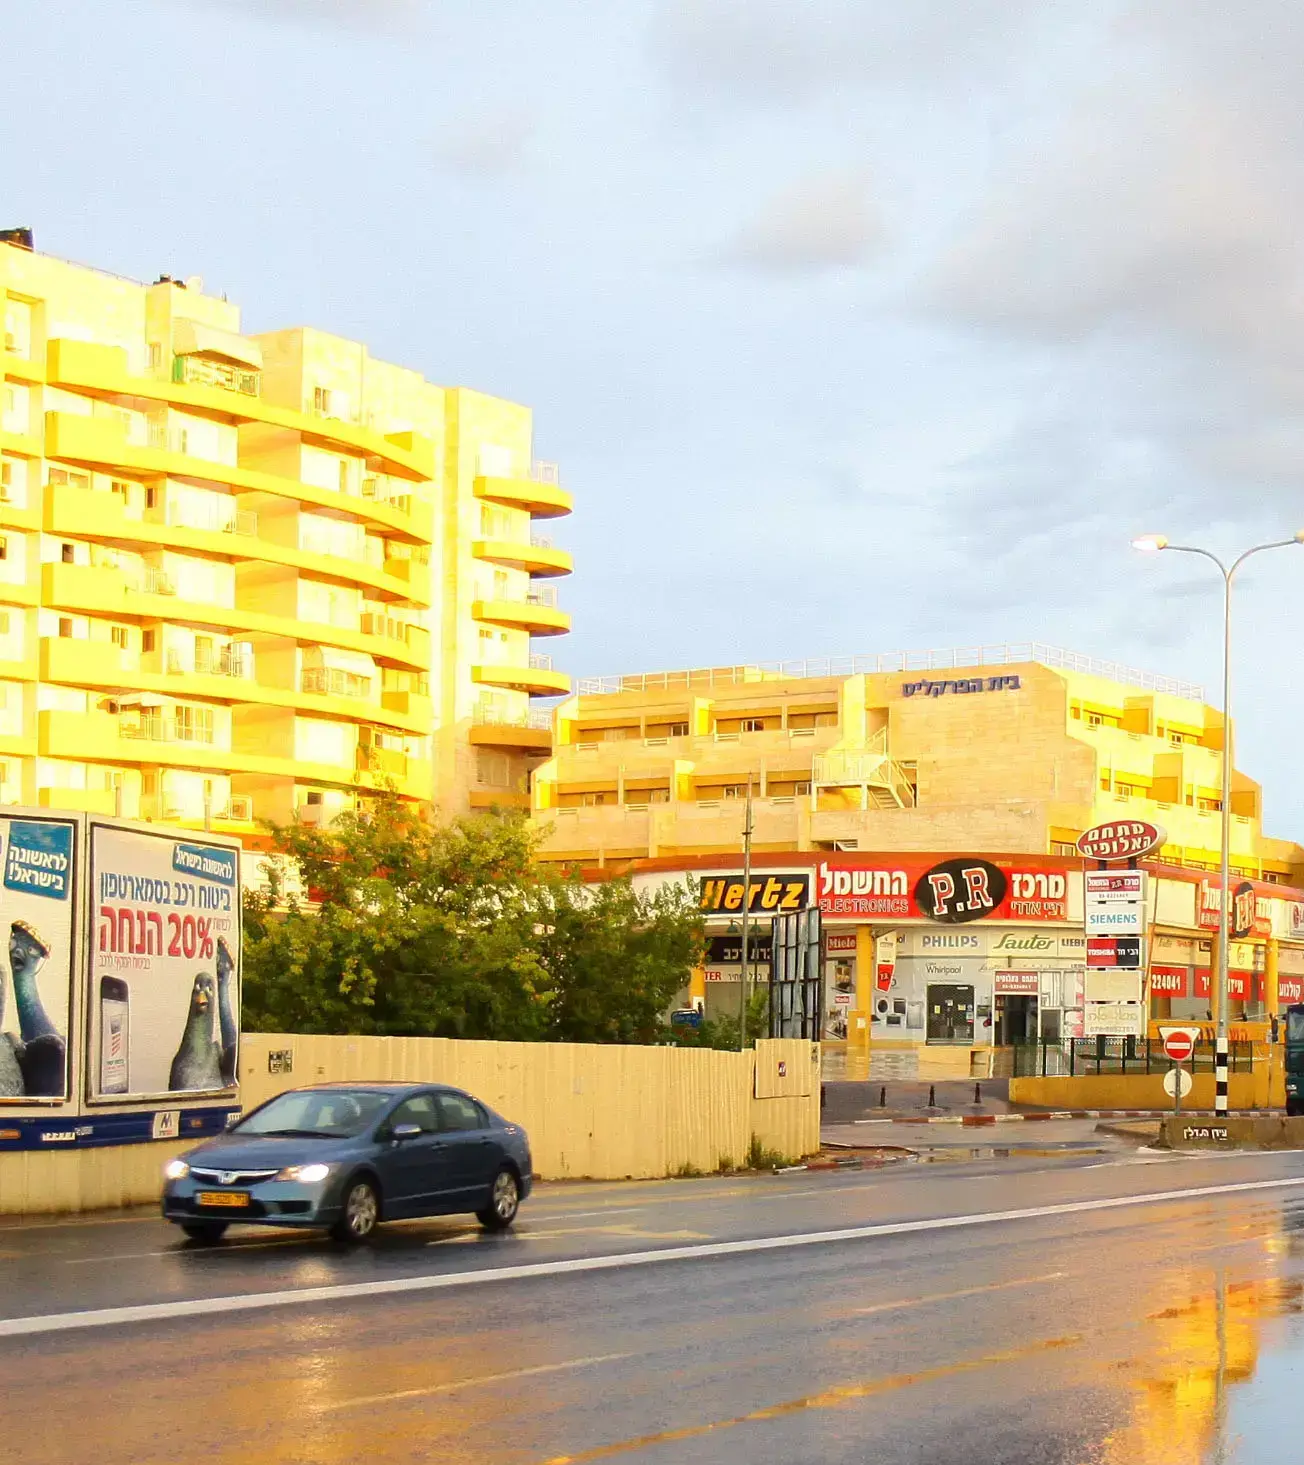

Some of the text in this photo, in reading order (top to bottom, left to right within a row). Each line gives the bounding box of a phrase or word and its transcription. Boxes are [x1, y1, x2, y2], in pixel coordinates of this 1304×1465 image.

[988, 675, 1021, 691] בית
[1088, 823, 1144, 841] מתחם
[1084, 835, 1151, 856] האלופים
[9, 846, 68, 872] לראשונה
[176, 845, 232, 879] לראשונה בישראל
[8, 862, 64, 890] בישראל!
[100, 872, 231, 911] ביטוח רכב בסמארטפון
[700, 877, 804, 909] Hertz
[820, 862, 1065, 916] מרכז P.R החשמל
[820, 899, 909, 913] ELECTRONICS
[1090, 914, 1137, 924] SIEMENS
[99, 906, 214, 960] 20% הנחה
[922, 936, 978, 948] PHILIPS
[993, 933, 1055, 950] Sauter
[828, 936, 857, 950] Miele
[1088, 948, 1115, 956] TOSHIBA
[926, 965, 962, 977] Whirlpool
